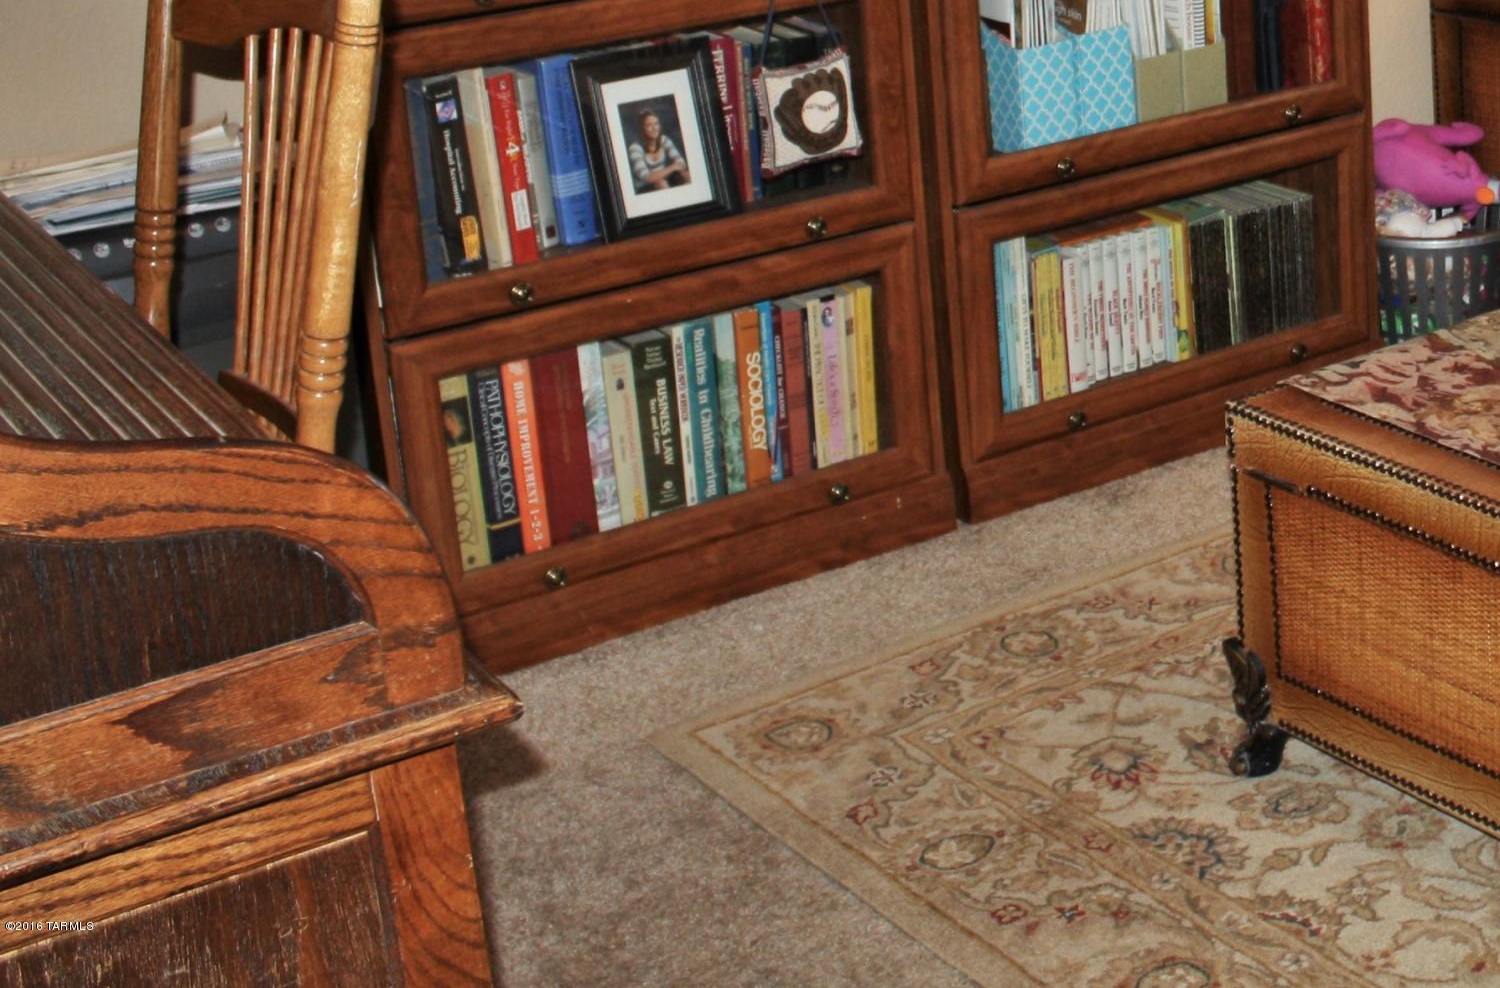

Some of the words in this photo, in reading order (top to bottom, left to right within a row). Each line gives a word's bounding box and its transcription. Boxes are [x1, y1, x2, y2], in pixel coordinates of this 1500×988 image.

[505, 141, 520, 158] 4
[443, 129, 455, 164] Hospital
[449, 167, 462, 215] Accounting
[1070, 278, 1079, 321] BEGINNER'S
[693, 328, 709, 385] Realities
[774, 335, 783, 375] CHECKLIST
[478, 381, 488, 410] Clinical
[512, 381, 527, 415] HOME
[648, 397, 658, 413] Text
[655, 378, 671, 436] BUSINESS
[698, 389, 711, 404] in
[746, 351, 768, 450] SOCIOLOGY
[777, 388, 786, 419] CHANGE
[480, 410, 493, 442] Concepts
[650, 416, 659, 430] and
[485, 379, 517, 516] PATHOPHYSIOLOGY
[651, 432, 661, 455] Cases
[661, 438, 675, 466] LAW
[700, 408, 718, 496] Childbearing
[517, 419, 539, 505] IMPROVEMENT
[449, 449, 474, 546] BIOLOGY
[529, 509, 544, 542] 1-2-3
